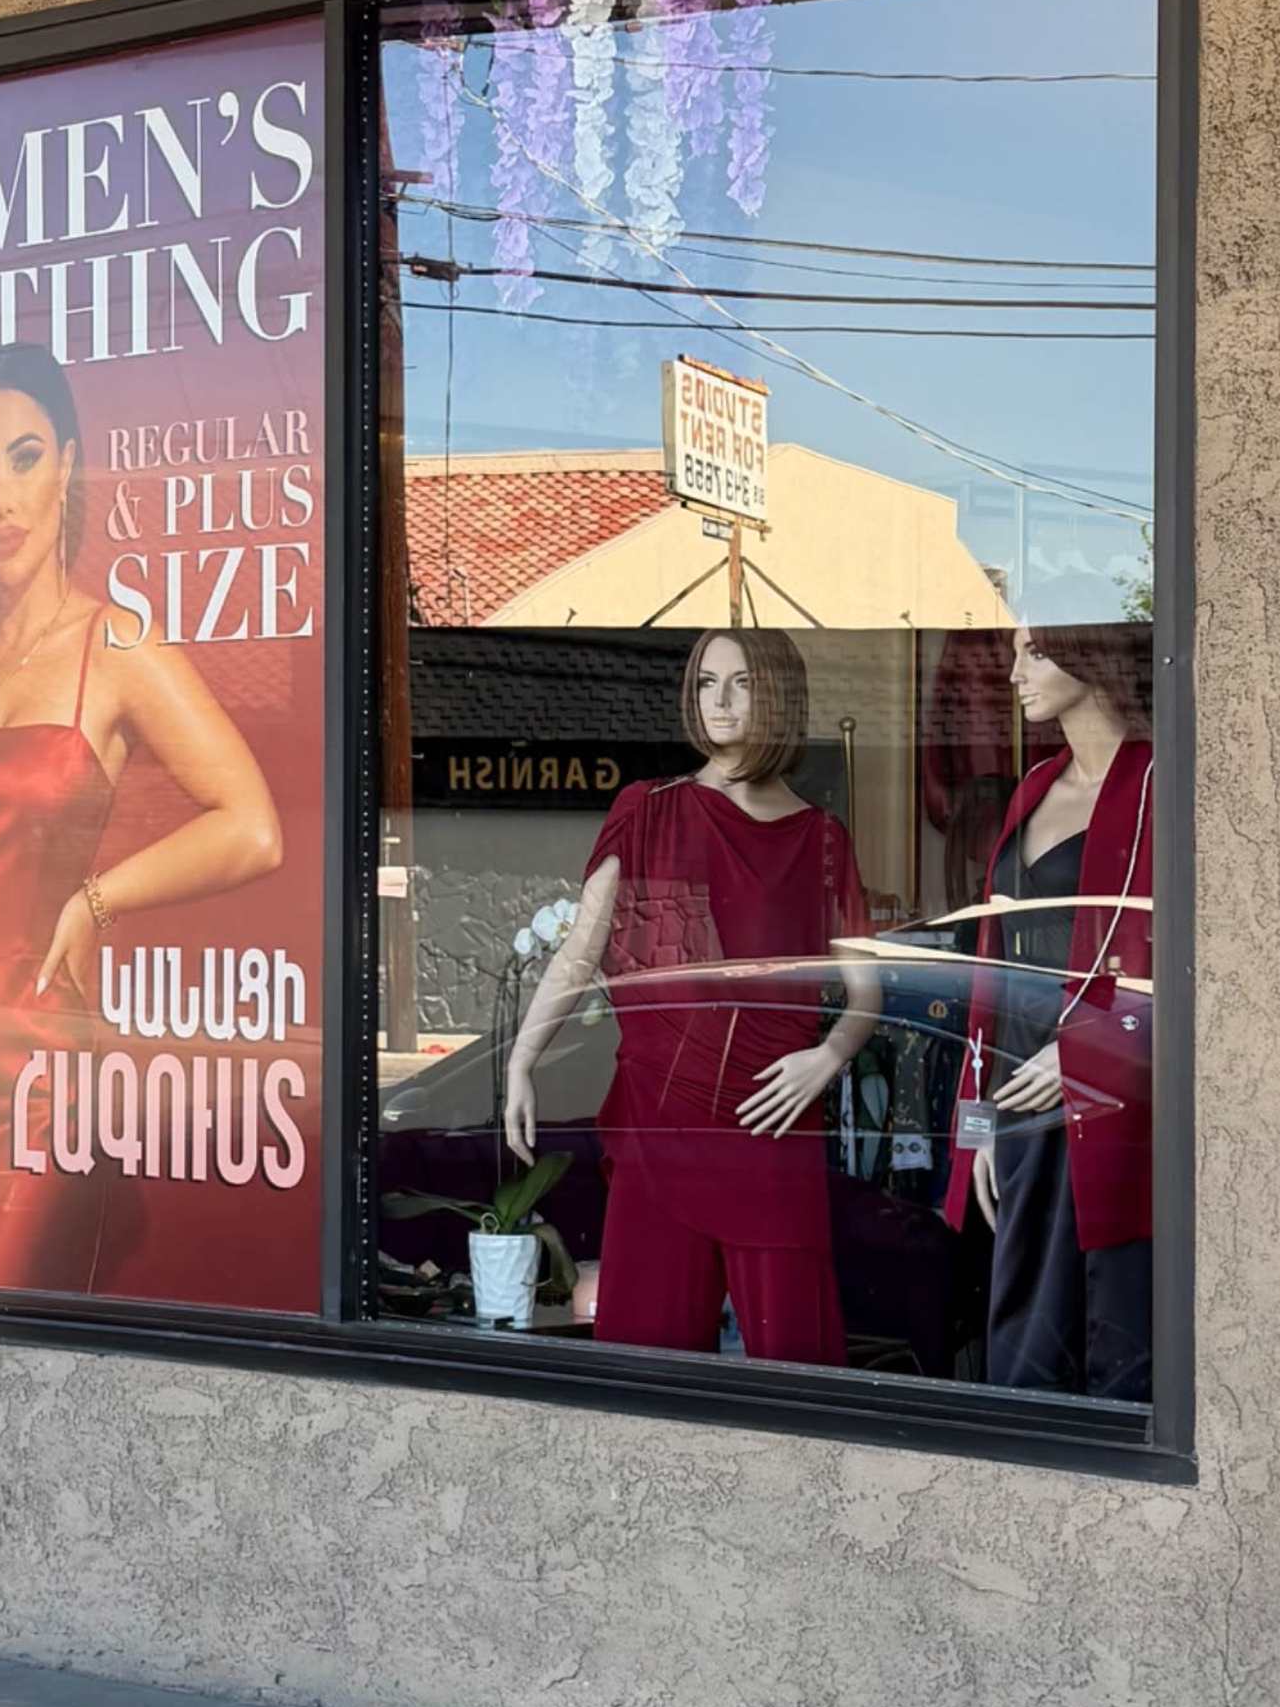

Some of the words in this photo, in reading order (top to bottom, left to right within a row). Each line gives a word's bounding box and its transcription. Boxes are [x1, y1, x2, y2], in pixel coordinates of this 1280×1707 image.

[107, 409, 311, 472] REGULAR
[106, 480, 143, 541] &
[162, 463, 315, 536] PLUS
[105, 542, 314, 651] SIZE
[101, 945, 306, 1042] ԿԱՆԱՑԻ
[13, 1049, 306, 1189] ՀԱԳՈՒՍՏ
